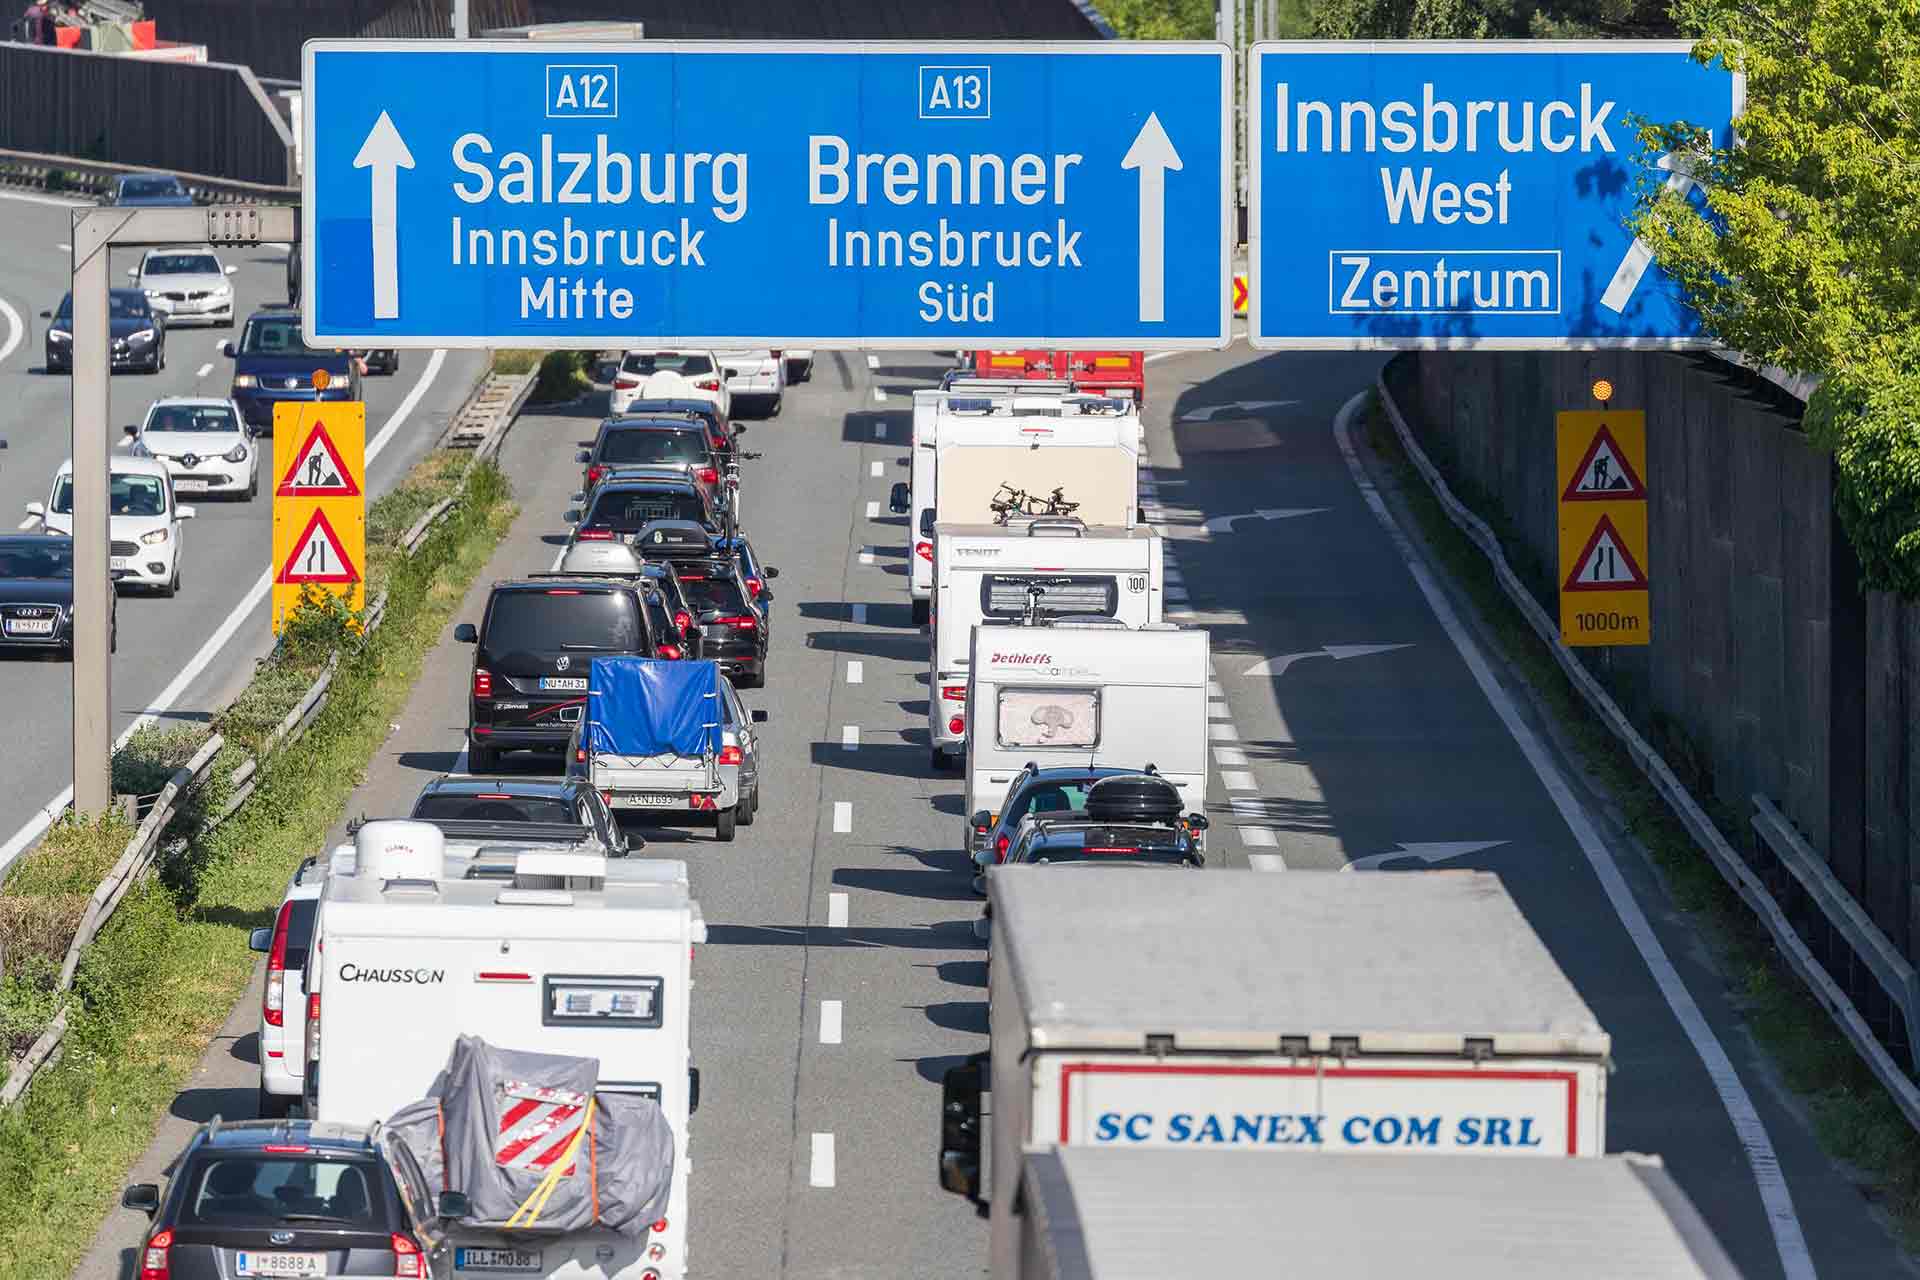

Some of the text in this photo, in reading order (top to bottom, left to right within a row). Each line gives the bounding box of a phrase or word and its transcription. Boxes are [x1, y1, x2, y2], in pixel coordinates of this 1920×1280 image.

[557, 75, 609, 108] A12
[930, 76, 981, 109] A13
[1277, 83, 1616, 152] Innsbruck
[452, 133, 748, 223] Salzburg
[809, 136, 1082, 204] Brenner
[1381, 167, 1511, 224] West
[453, 217, 706, 265] Innsbruck
[829, 219, 1082, 267] Innsbruck
[521, 277, 634, 319] Mitte
[919, 281, 994, 322] Süd
[1341, 257, 1550, 308] Zentrum
[1129, 577, 1145, 591] 100
[1575, 612, 1640, 632] 1000m
[1096, 1112, 1542, 1148] SC SANEX COM SRL
